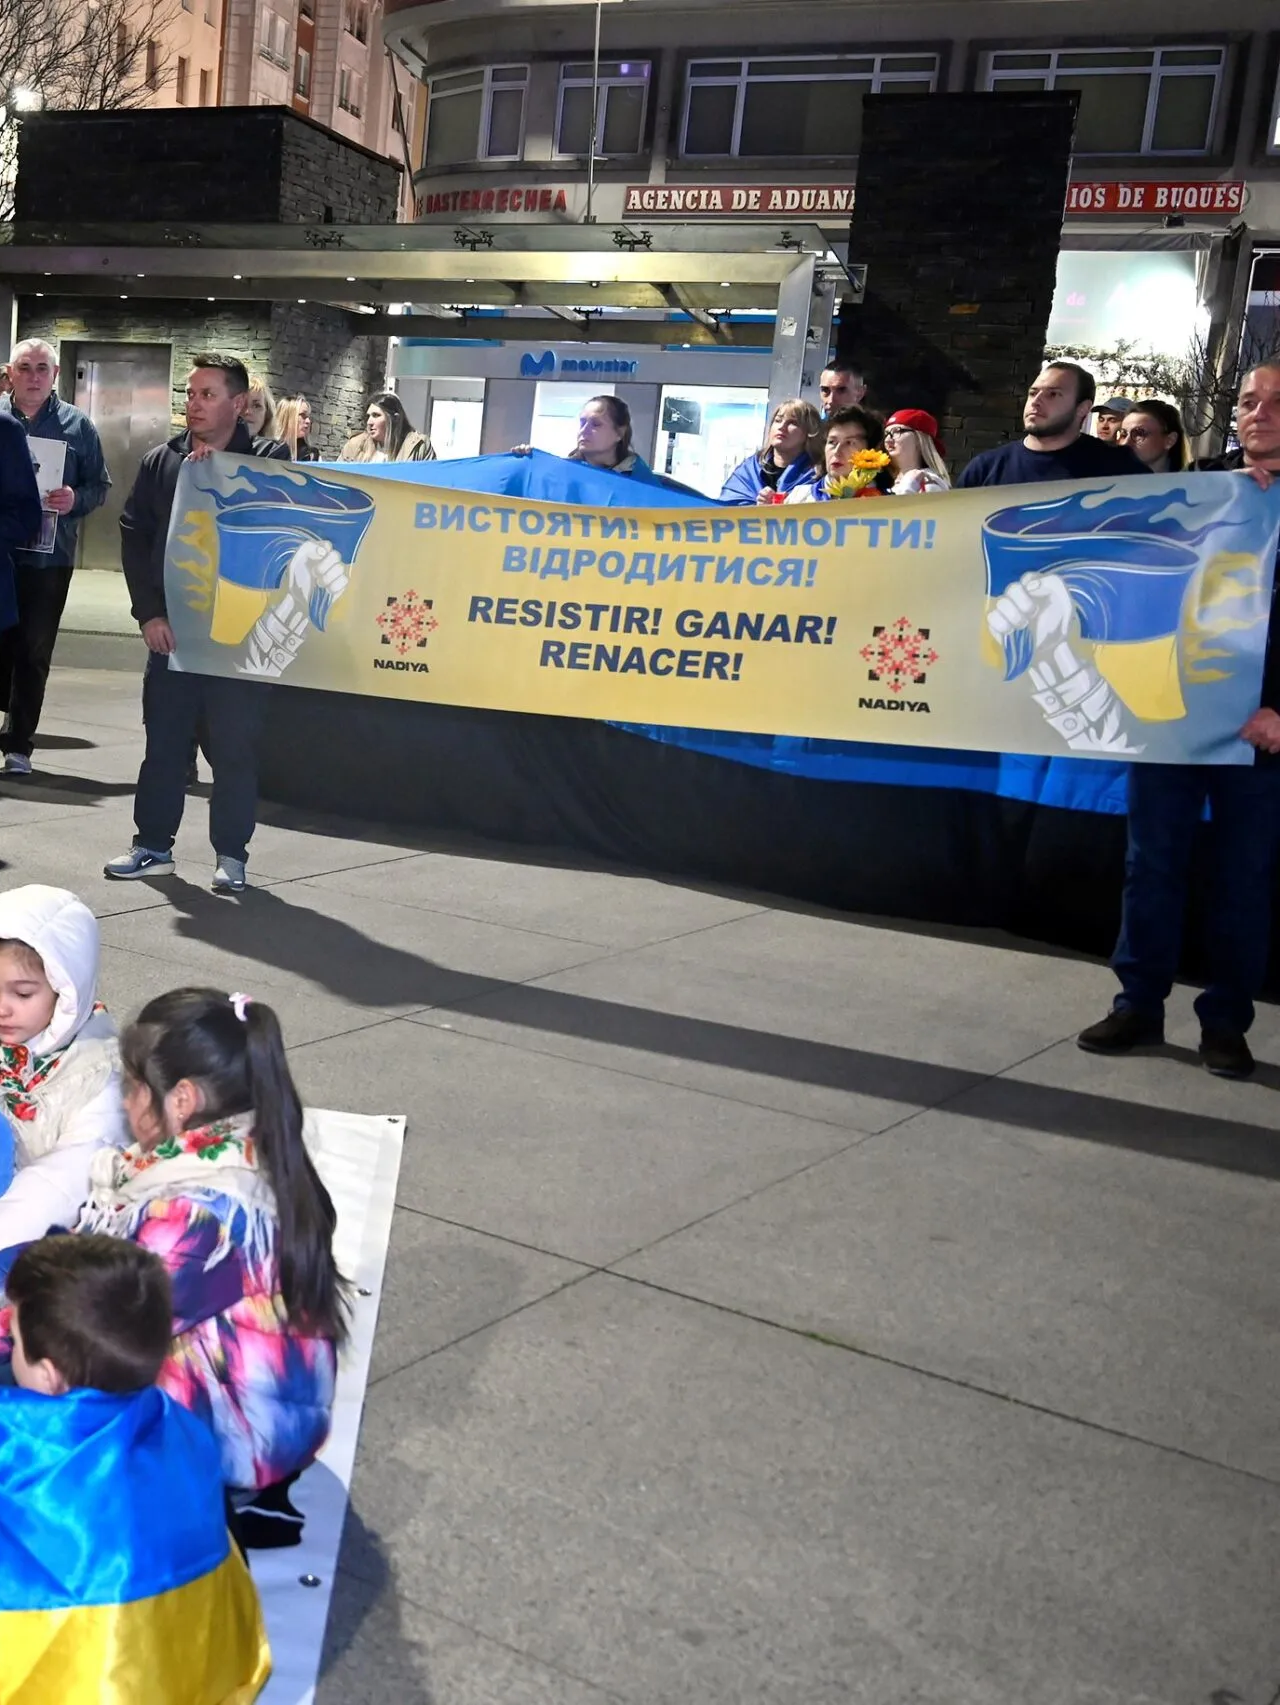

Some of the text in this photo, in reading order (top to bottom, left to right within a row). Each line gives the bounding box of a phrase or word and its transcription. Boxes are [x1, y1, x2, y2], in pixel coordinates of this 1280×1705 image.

[626, 189, 723, 211] AGENCIA
[731, 189, 761, 210] DE
[1117, 187, 1145, 208] DE
[1154, 187, 1241, 208] BUQUES
[413, 502, 937, 549] ВИСТОЯТИ! ПЕРЕМОГТИ!
[502, 545, 819, 588] ВІДРОДИТИСЯ!
[467, 595, 838, 645] RESISTIR! GANAR!
[373, 658, 430, 673] NADIYA
[539, 640, 744, 681] RENACER!
[858, 697, 932, 714] NADIYA
